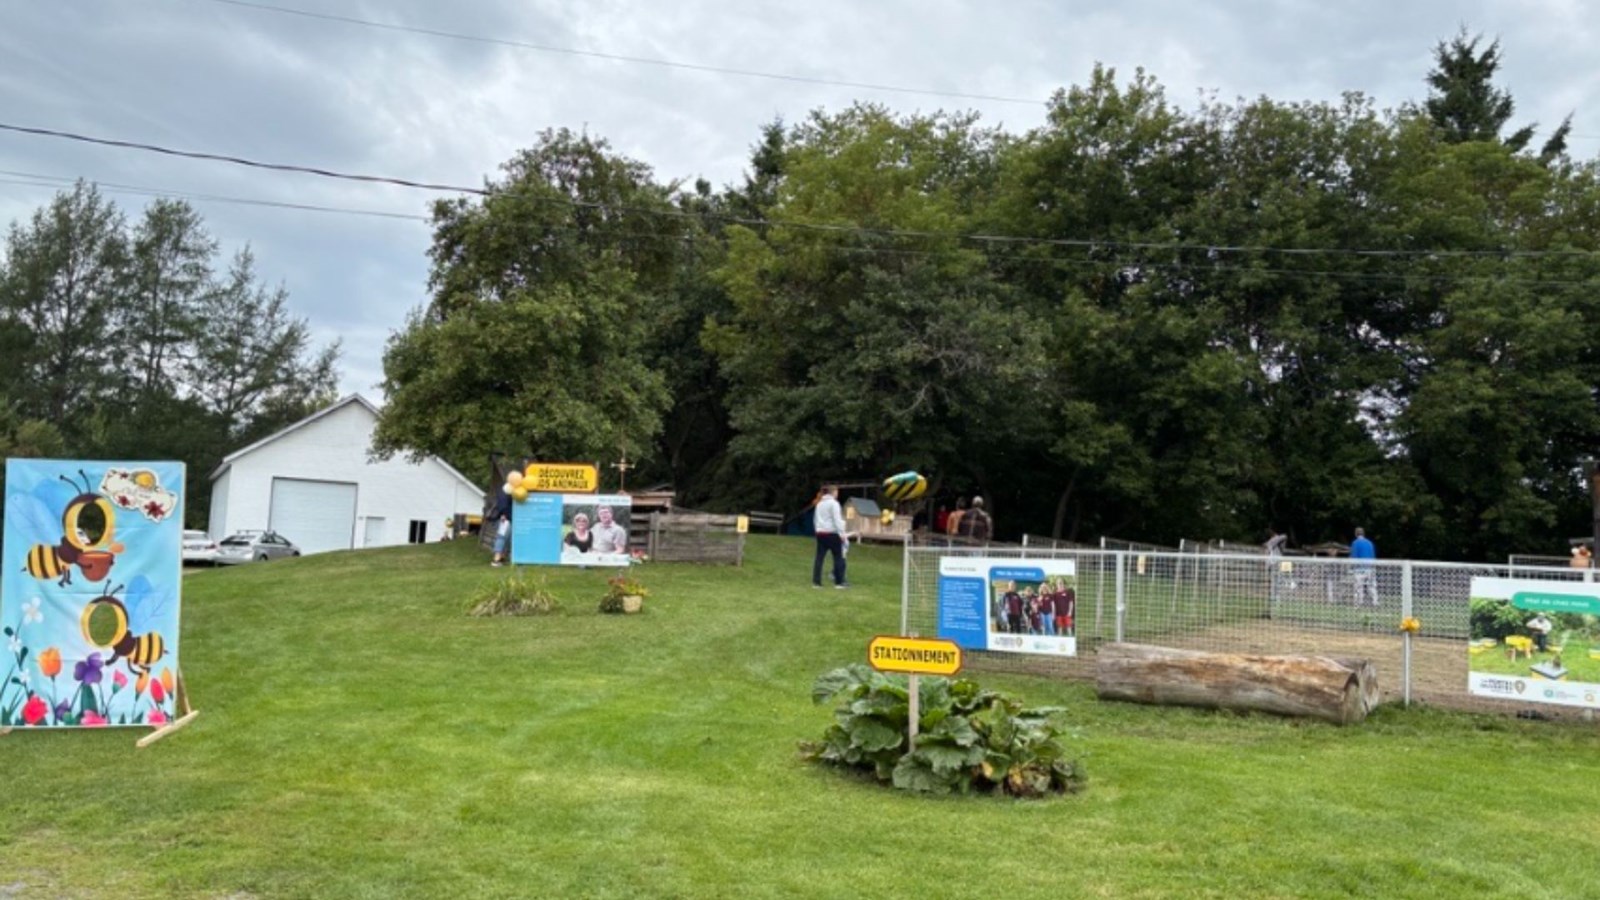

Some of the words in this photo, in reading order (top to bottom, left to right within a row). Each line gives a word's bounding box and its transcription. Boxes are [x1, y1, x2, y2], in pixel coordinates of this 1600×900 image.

[538, 467, 585, 479] DÉCOUVREZ
[536, 479, 550, 489] OS
[552, 480, 588, 490] ANIMAUX
[873, 645, 957, 665] STATIONNEMENT
